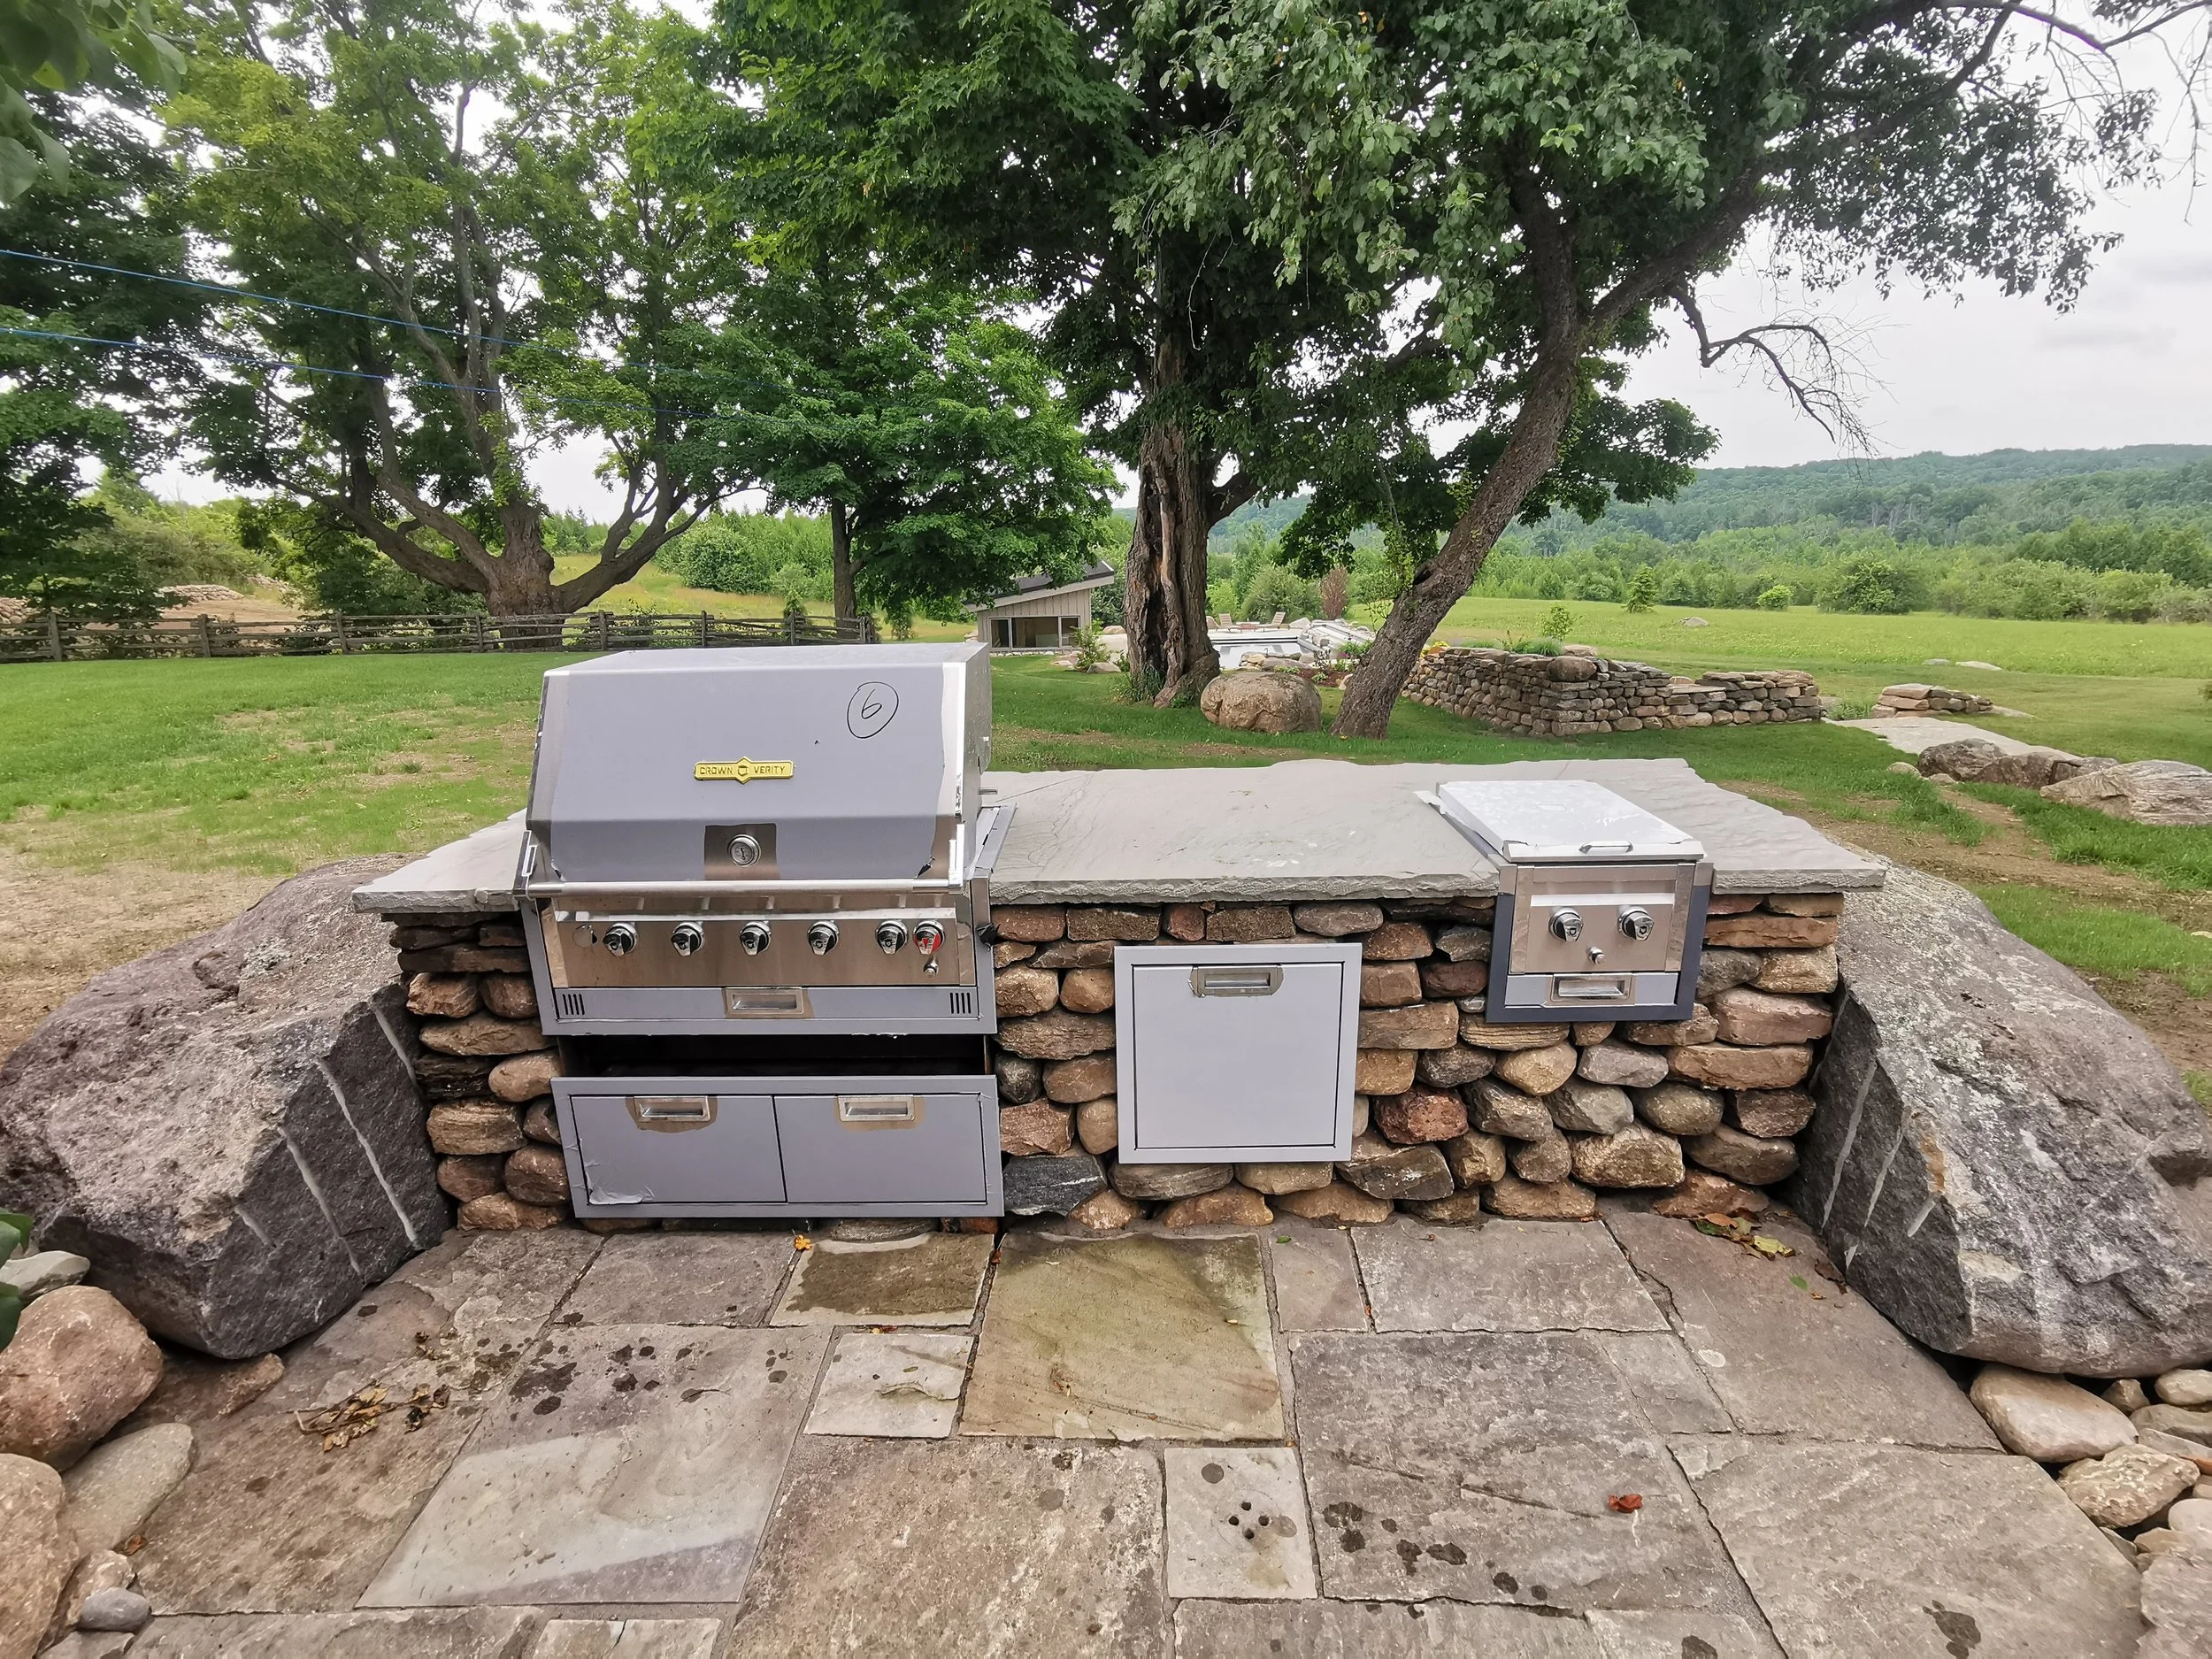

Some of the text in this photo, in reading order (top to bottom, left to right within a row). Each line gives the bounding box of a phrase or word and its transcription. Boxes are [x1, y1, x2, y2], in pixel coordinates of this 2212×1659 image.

[861, 688, 882, 719] 6
[699, 765, 786, 775] CROWN VERITY
